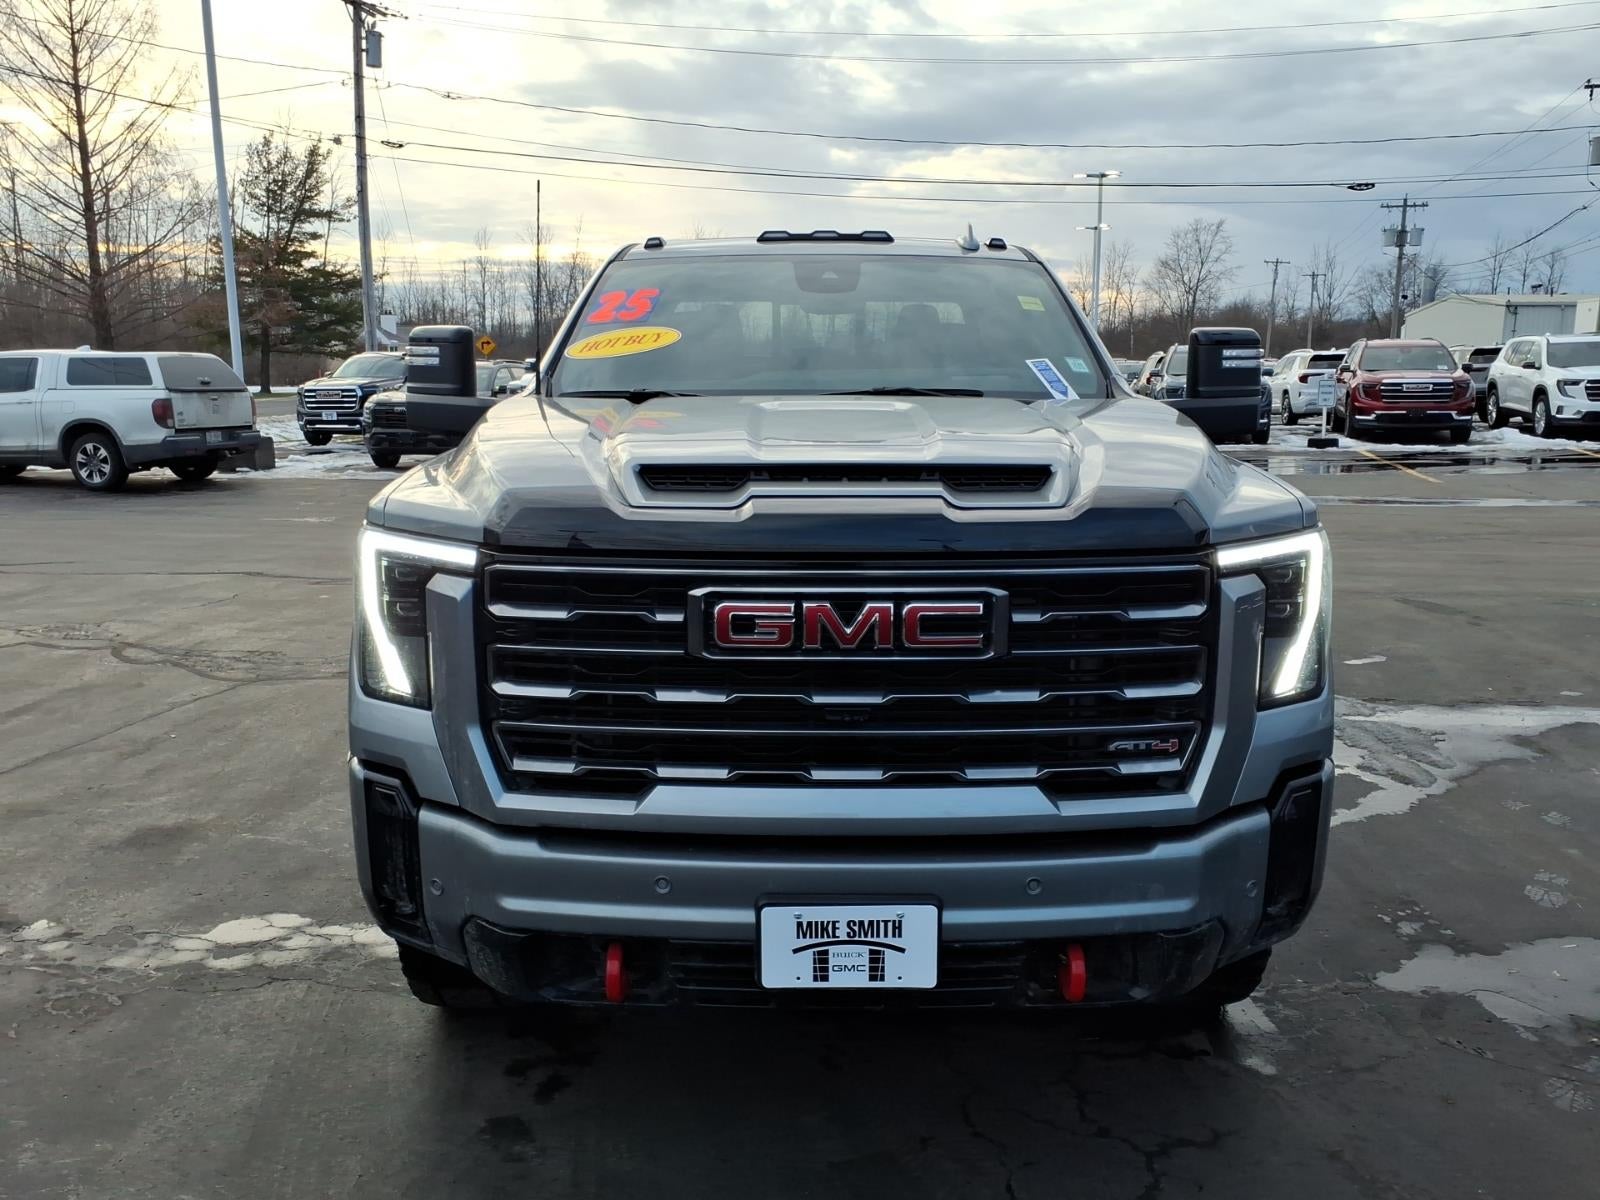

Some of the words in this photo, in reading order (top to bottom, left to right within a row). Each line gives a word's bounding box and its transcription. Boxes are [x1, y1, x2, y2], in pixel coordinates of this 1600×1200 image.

[587, 288, 660, 323] 25
[578, 336, 626, 353] HOT
[623, 331, 669, 346] BUY
[714, 601, 984, 649] GMC
[1108, 739, 1179, 752] AT4
[796, 920, 840, 939] MIKE
[846, 919, 903, 939] SMITH
[831, 964, 867, 973] GMC
